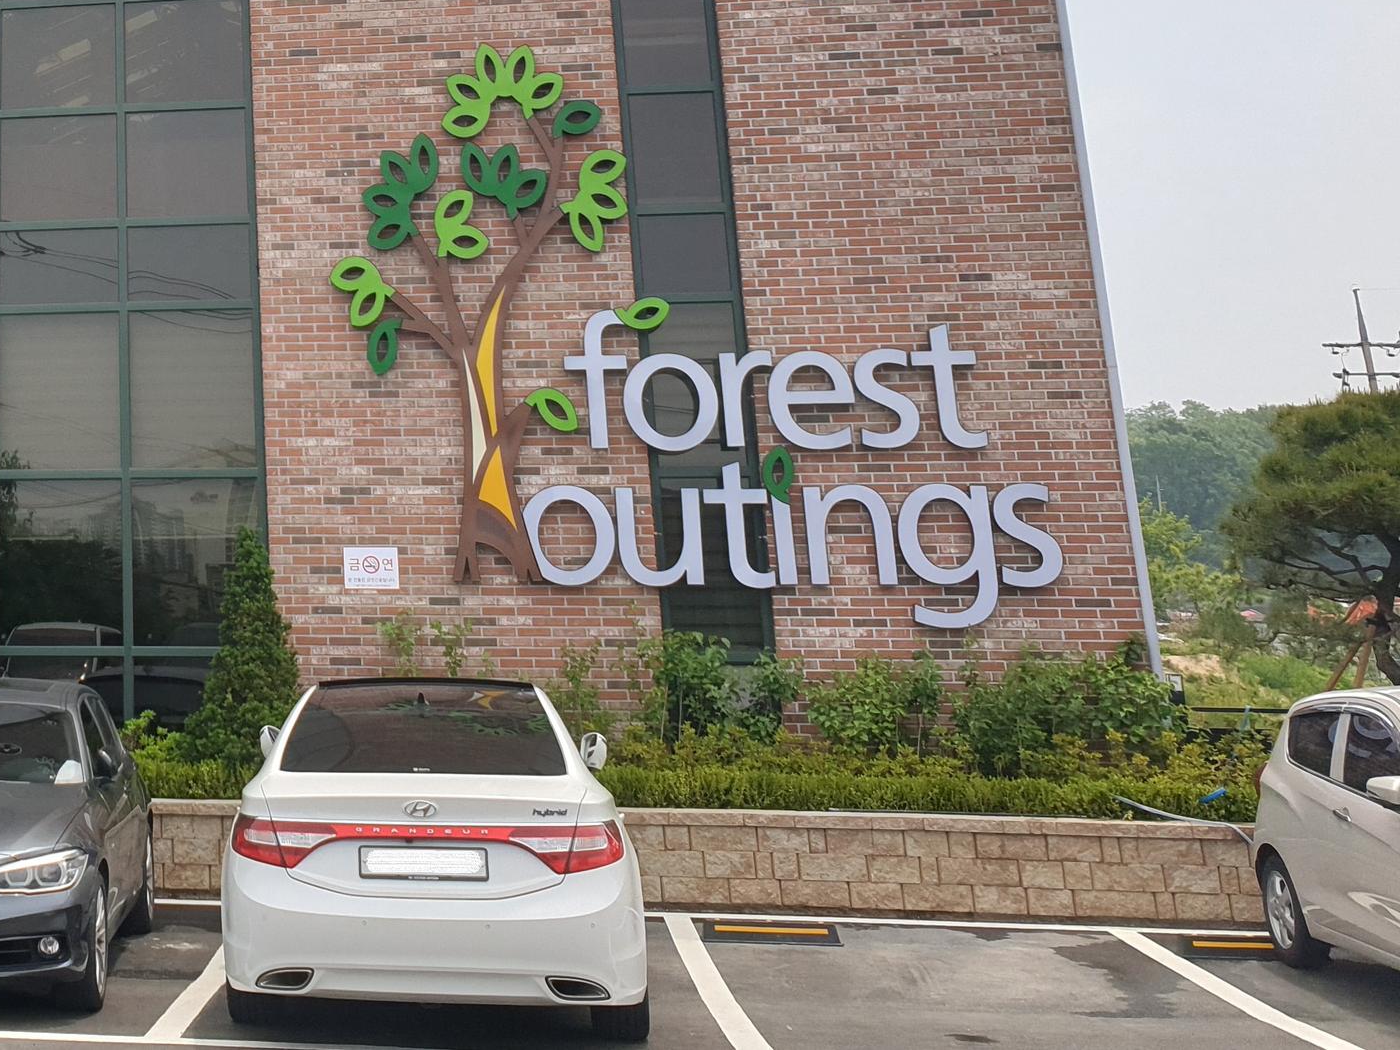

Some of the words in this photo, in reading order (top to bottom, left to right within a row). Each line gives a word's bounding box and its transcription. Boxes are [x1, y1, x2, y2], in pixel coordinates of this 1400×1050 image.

[564, 308, 989, 451] forest
[523, 462, 1064, 628] outings
[355, 826, 489, 836] GRANDEUR
